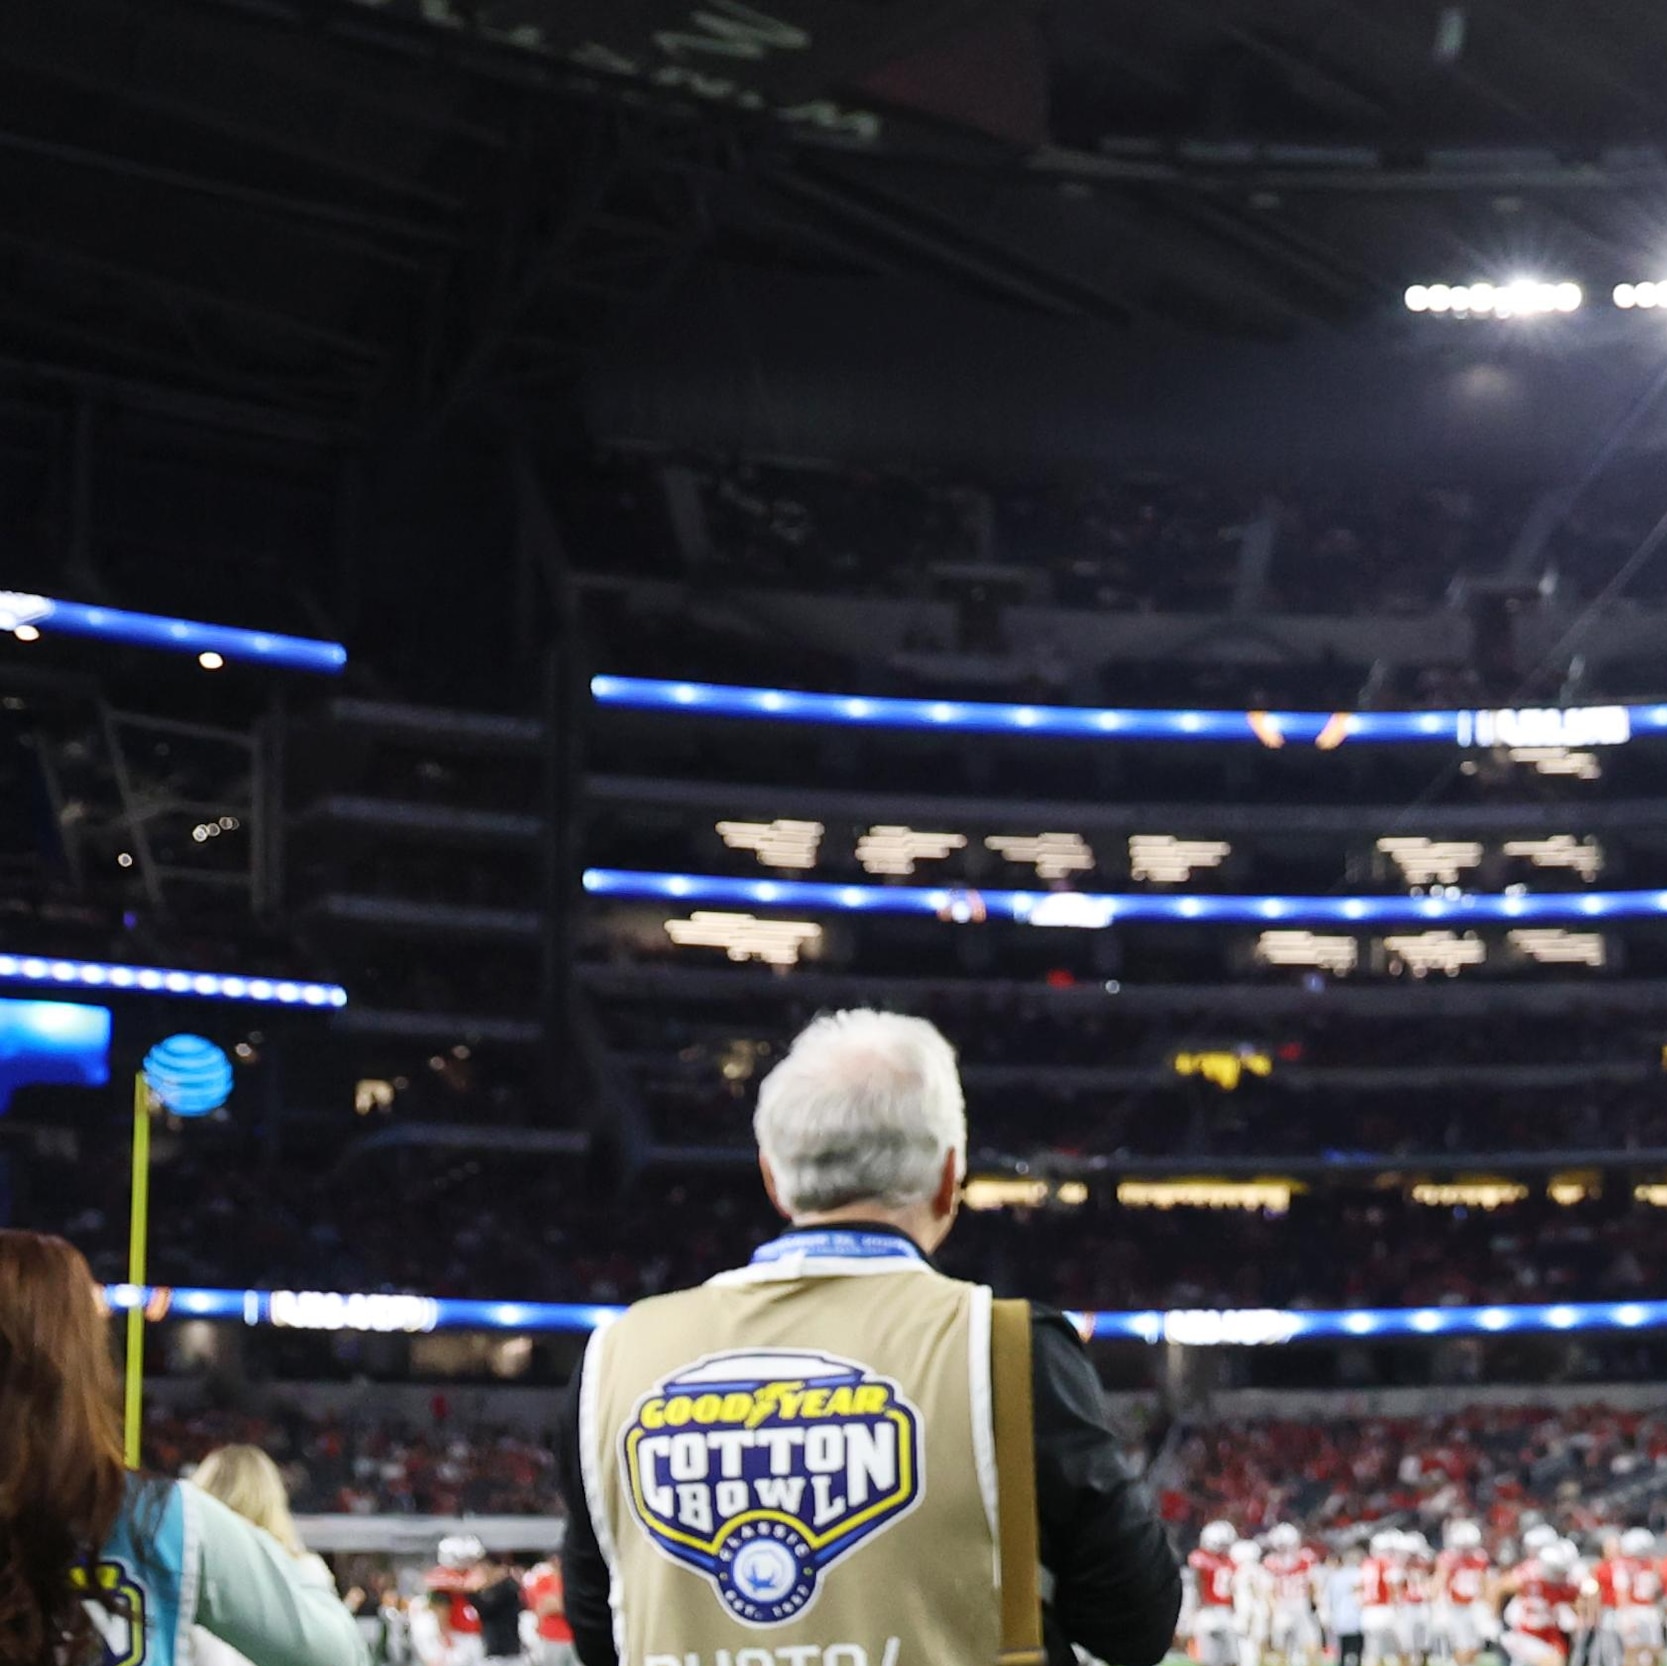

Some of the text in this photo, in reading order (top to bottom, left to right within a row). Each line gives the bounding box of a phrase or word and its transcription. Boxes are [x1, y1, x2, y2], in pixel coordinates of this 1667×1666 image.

[640, 1381, 889, 1429] GOODYEAR
[637, 1421, 896, 1520] COTTON
[676, 1474, 846, 1534] BOWL
